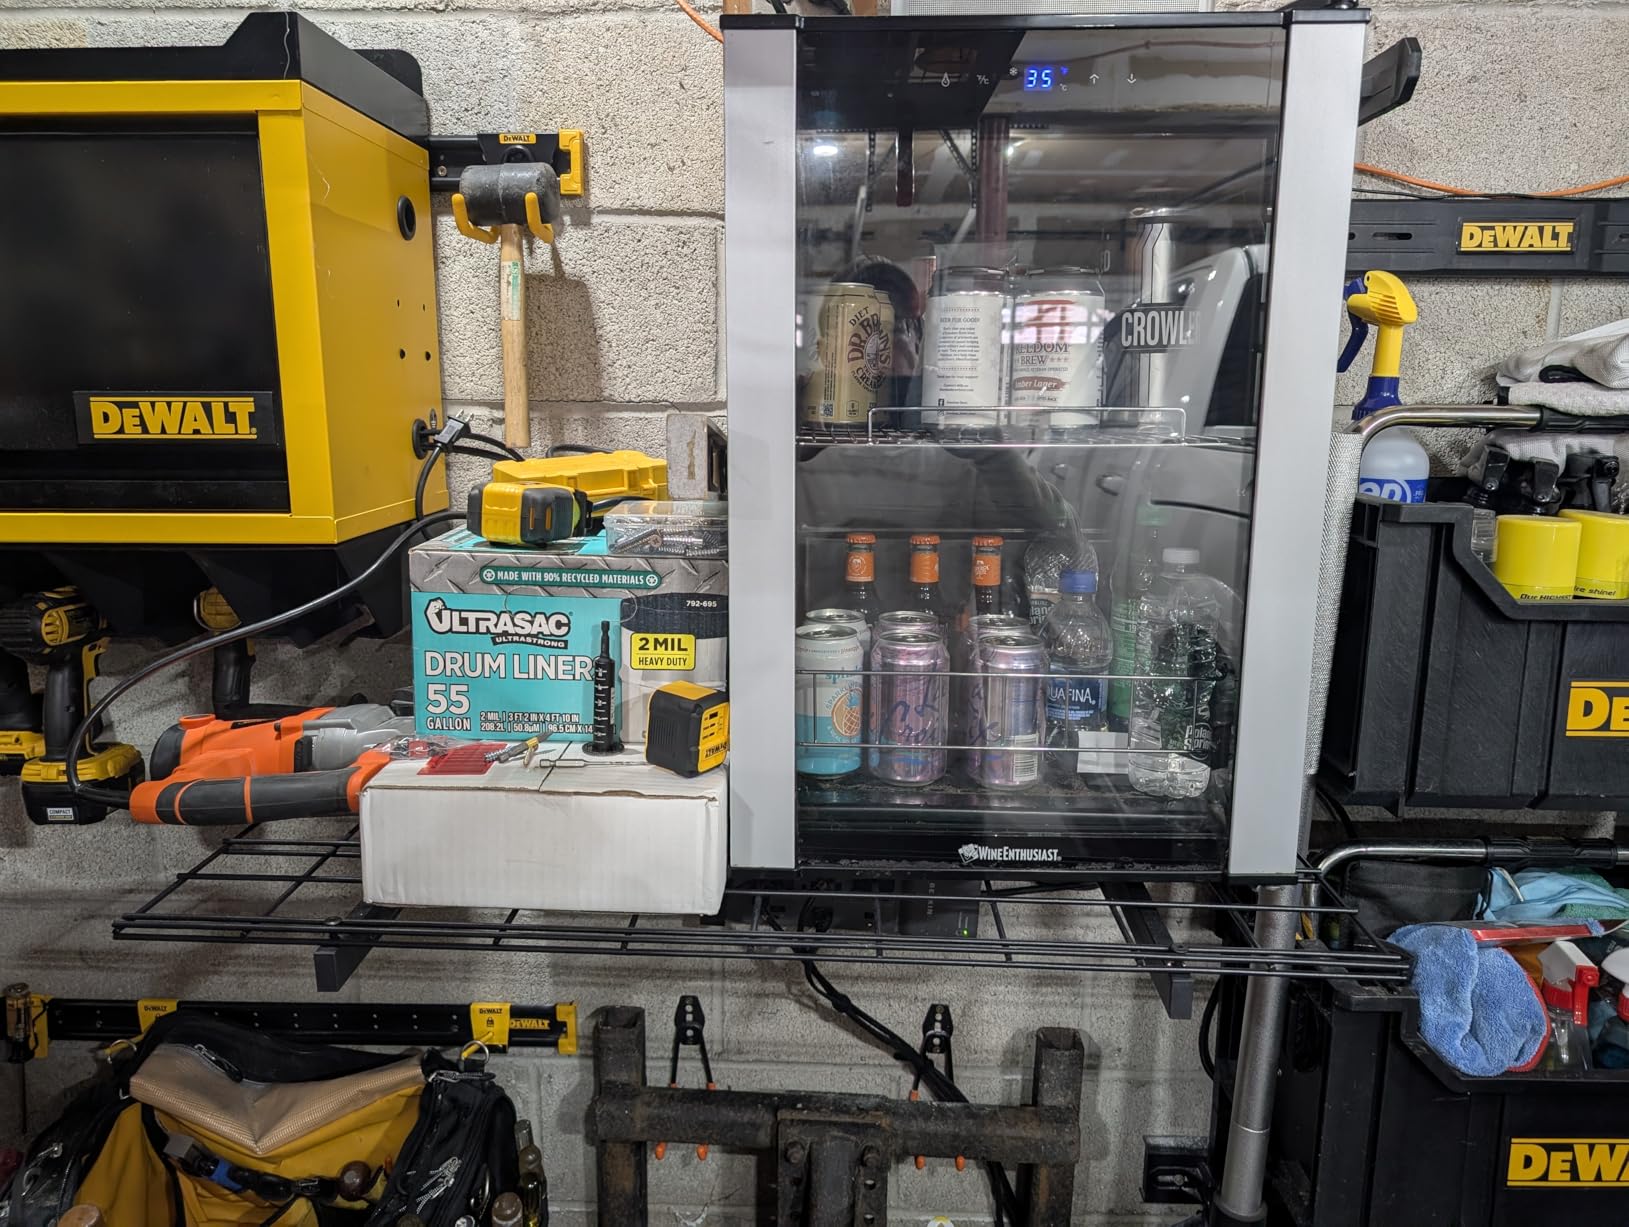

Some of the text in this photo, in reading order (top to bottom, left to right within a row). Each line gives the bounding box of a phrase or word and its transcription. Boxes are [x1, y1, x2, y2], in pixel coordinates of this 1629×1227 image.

[1025, 69, 1052, 89] 35
[849, 306, 870, 327] DIET
[1020, 355, 1048, 366] BREW
[497, 571, 644, 585] MADE WITH 90% RECYCLED MATERIALS
[1588, 588, 1616, 596] shine!
[686, 600, 717, 608] 792-695
[425, 598, 570, 637] ULTRASAC
[495, 634, 565, 648] ULTRASTRONG
[638, 637, 688, 652] 2 MIL
[425, 650, 506, 679] DRUM
[638, 656, 687, 667] HEAVY DUTY
[425, 682, 471, 715] 55
[426, 716, 471, 731] GALLON
[480, 712, 579, 723] 2 MIL 3 FT 2 IN X 4 FT 10 IN
[480, 722, 505, 731] 208.2L
[565, 724, 577, 733] CM
[577, 724, 583, 733] X
